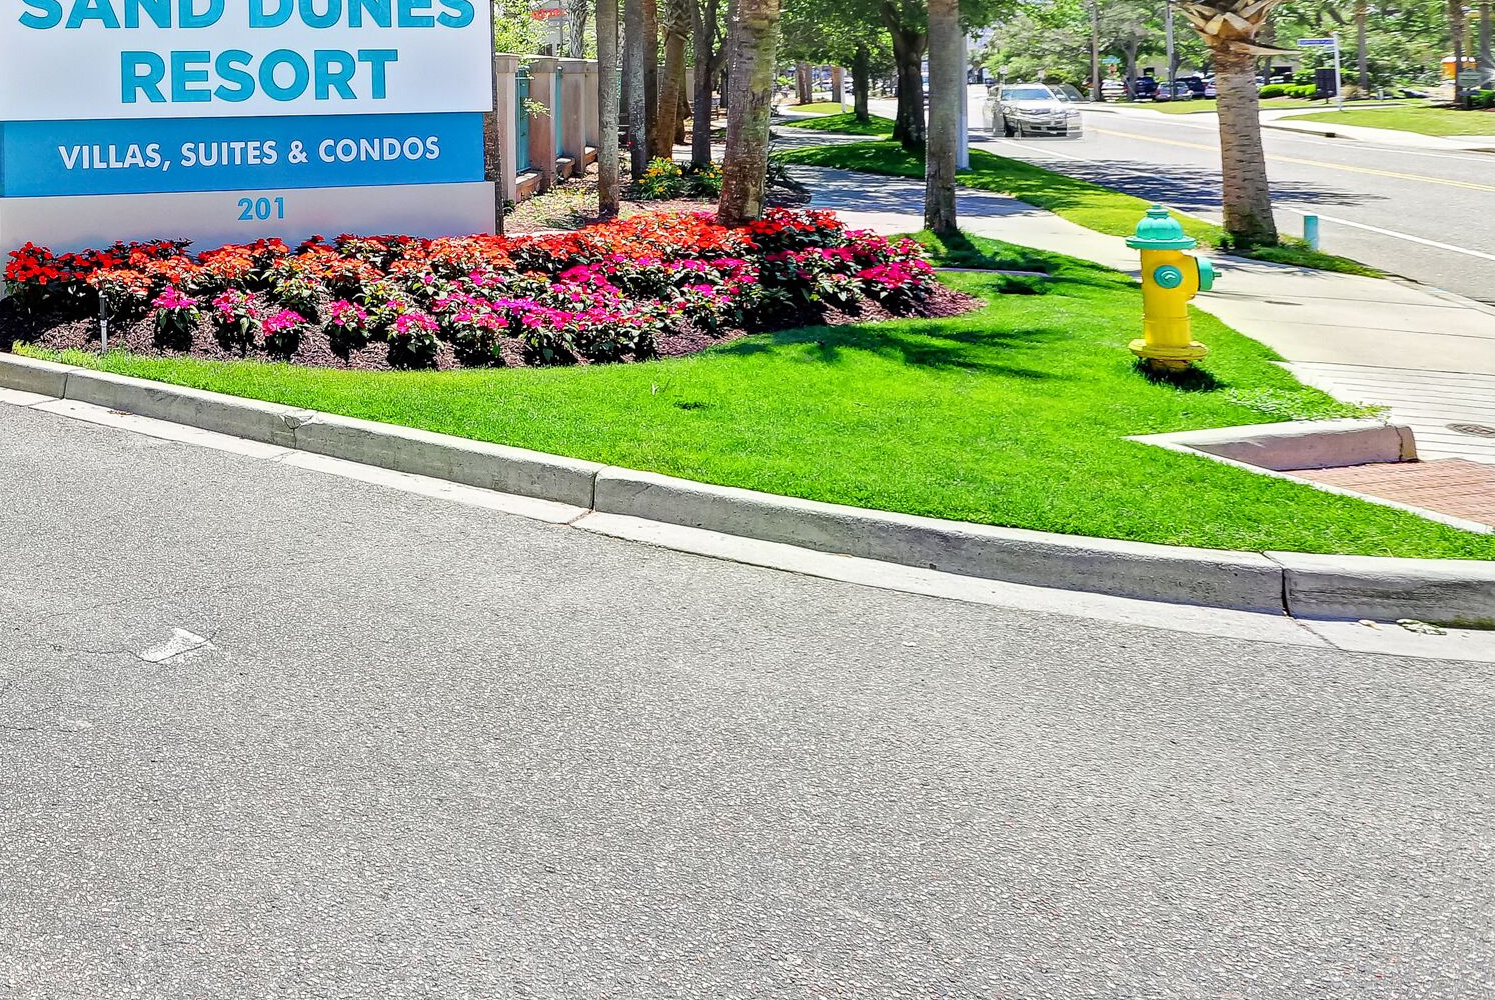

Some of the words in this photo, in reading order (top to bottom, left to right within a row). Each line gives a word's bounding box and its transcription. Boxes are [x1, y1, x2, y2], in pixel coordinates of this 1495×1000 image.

[121, 49, 398, 103] RESORT
[58, 143, 170, 171] VILLAS,
[181, 140, 279, 165] SUITES
[287, 140, 308, 162] &
[319, 136, 440, 162] CONDOS
[237, 197, 285, 221] 201
